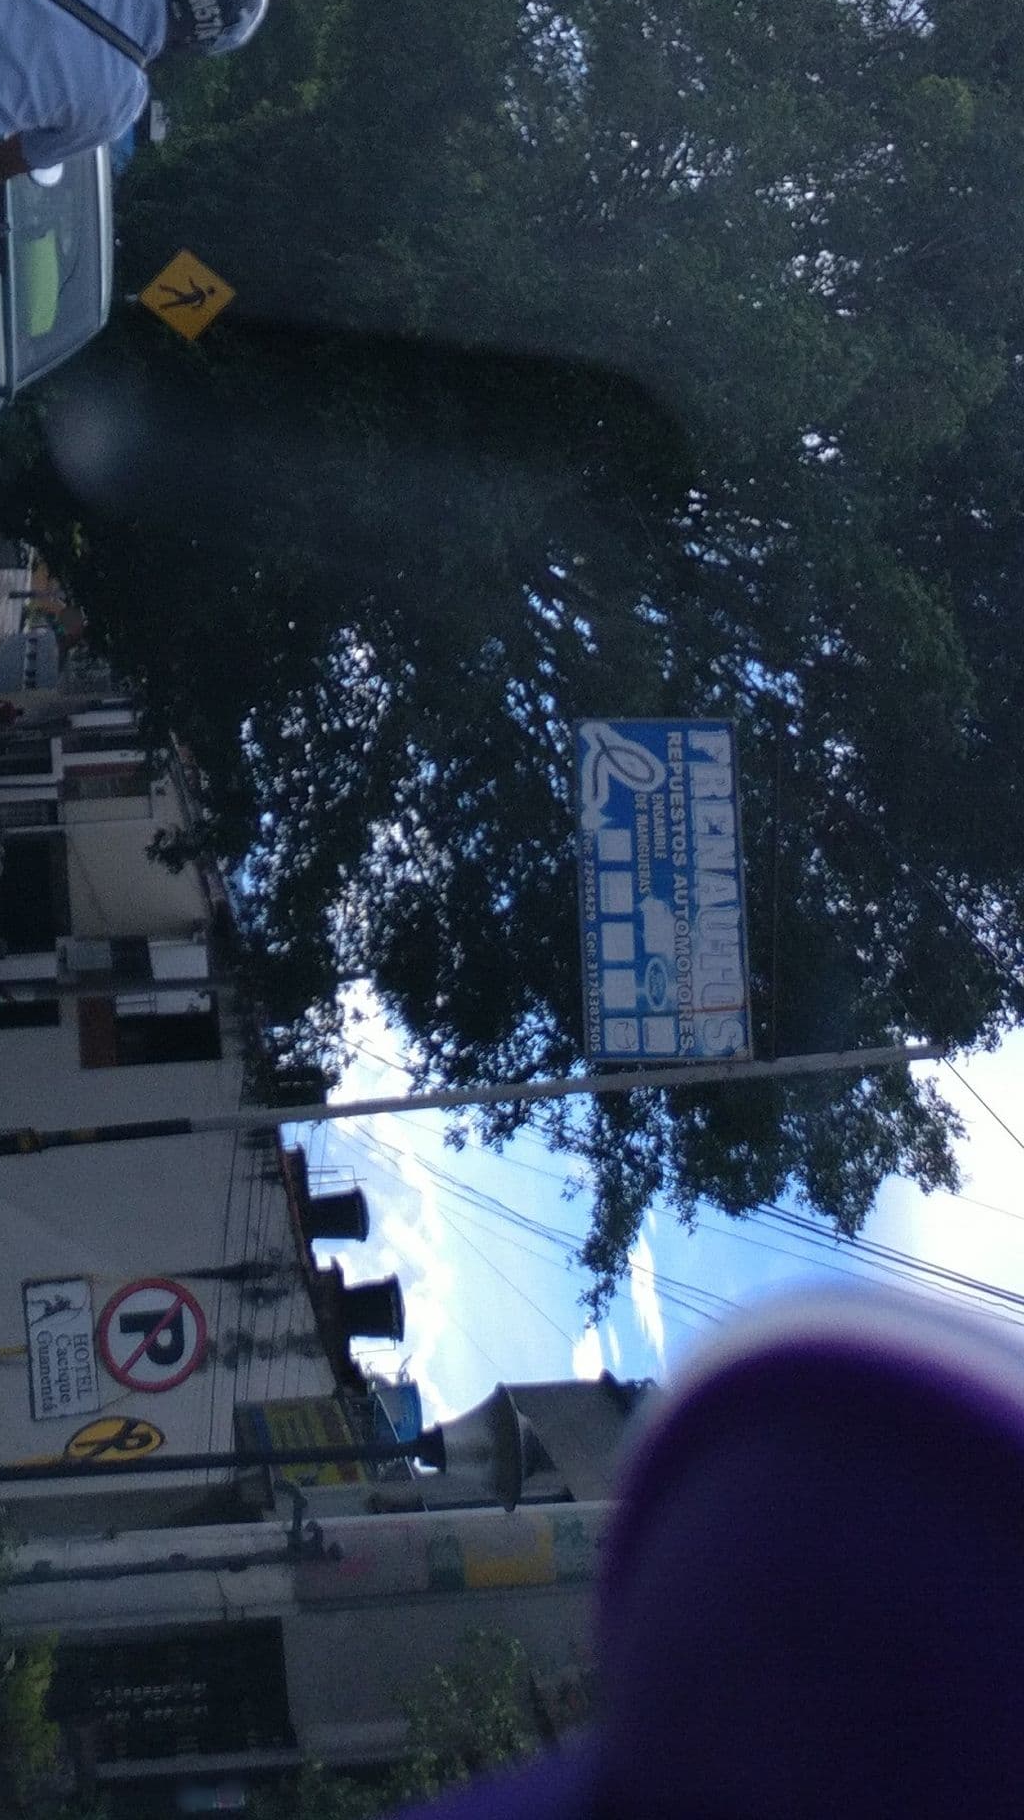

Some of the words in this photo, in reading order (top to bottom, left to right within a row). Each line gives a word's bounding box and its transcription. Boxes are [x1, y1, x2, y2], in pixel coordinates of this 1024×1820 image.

[634, 793, 648, 810] DE
[652, 793, 668, 859] ENSAMBLE
[667, 732, 687, 866] REPUESTOS
[636, 814, 651, 893] MANGUERAS
[673, 873, 695, 1051] AUTOMOTORES
[55, 1333, 73, 1404] Cacique
[73, 1333, 92, 1399] HOTEL
